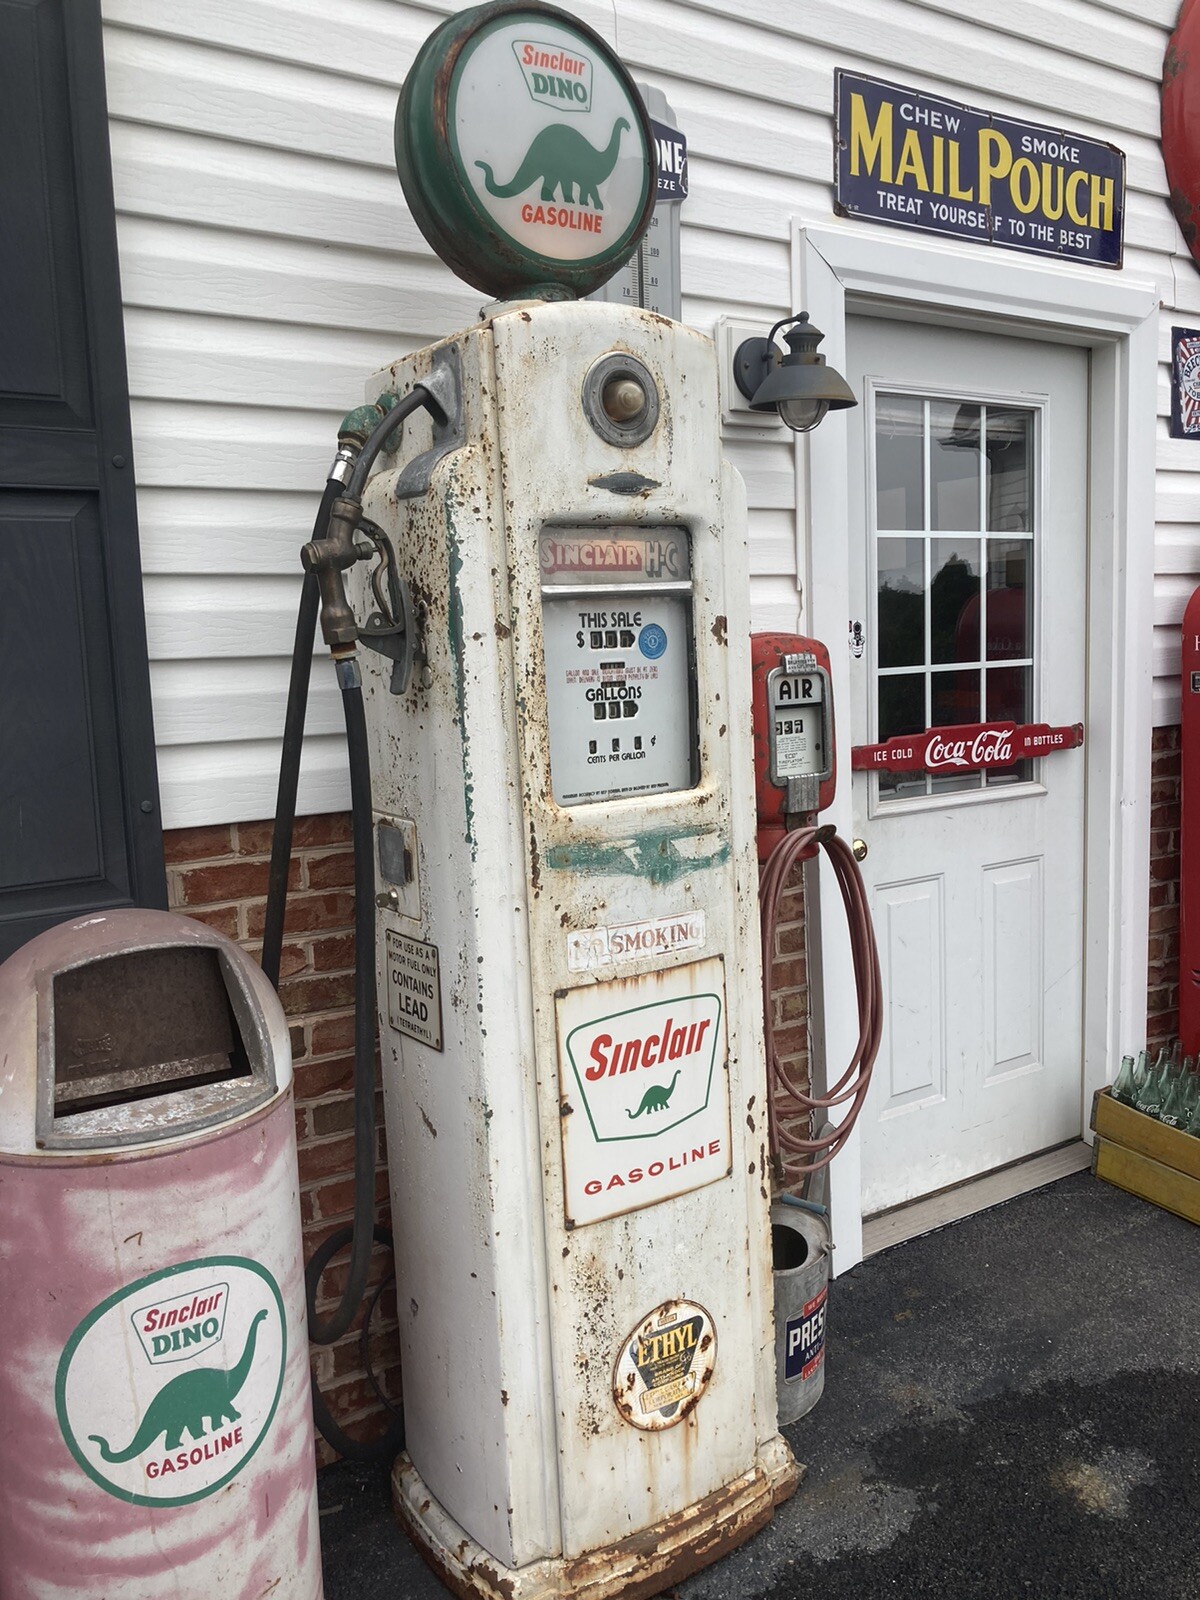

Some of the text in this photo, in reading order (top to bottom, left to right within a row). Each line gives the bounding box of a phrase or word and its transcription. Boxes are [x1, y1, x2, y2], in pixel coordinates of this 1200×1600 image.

[522, 44, 586, 76] Sinclair
[531, 72, 588, 103] DINO
[900, 103, 960, 134] CHEW
[850, 92, 1114, 232] MAIL POUCH
[1021, 136, 1080, 164] SMOKE
[522, 204, 602, 234] GASOLINE
[877, 190, 924, 216] TREAT
[930, 202, 1002, 232] YOURSEF
[1008, 218, 1026, 237] TO
[1029, 222, 1054, 242] THE
[1060, 230, 1092, 250] BEST
[540, 538, 642, 575] SINCLAIR
[579, 612, 642, 628] THIS SALE
[586, 686, 642, 702] GALLONS
[780, 679, 813, 700] AIR
[874, 748, 912, 762] ICE COLD
[925, 730, 1014, 768] Coca-Cola
[1024, 734, 1063, 747] IN BOTTLES
[587, 751, 646, 764] CENTS PER GALLON
[392, 937, 430, 960] FOR USE AS A
[407, 958, 420, 972] FUEL
[422, 964, 436, 978] ONLY
[393, 970, 434, 1000] CONTAINS
[399, 992, 428, 1022] LEAD
[585, 1018, 712, 1082] Sinclair
[584, 1140, 721, 1196] GASOLINE
[144, 1292, 223, 1332] Sinclair
[152, 1318, 219, 1356] DINO
[638, 1322, 698, 1368] ETHYL
[146, 1427, 242, 1478] GASOLINE
